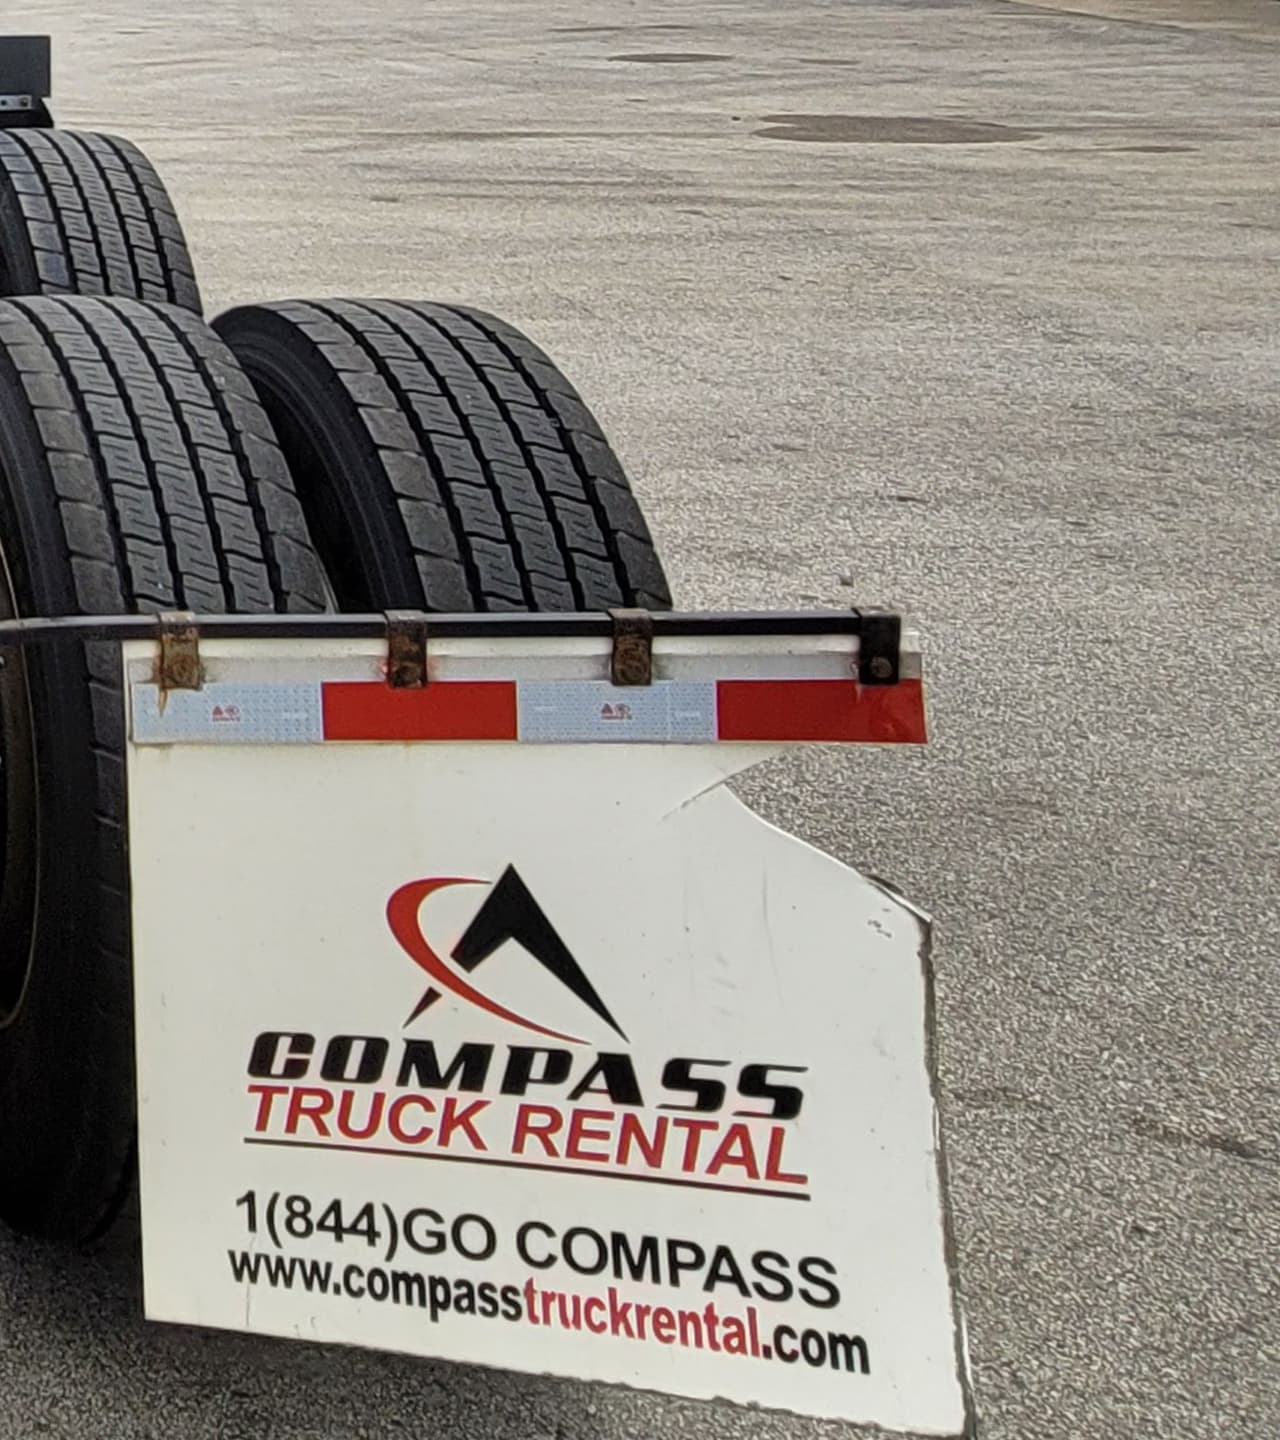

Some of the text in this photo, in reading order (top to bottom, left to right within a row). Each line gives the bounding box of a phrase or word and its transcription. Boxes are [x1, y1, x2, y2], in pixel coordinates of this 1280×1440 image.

[246, 1031, 809, 1121] COMPASS
[245, 1084, 809, 1185] TRUCK RENTAL
[227, 1246, 872, 1375] www.compasstruckrental.com
[516, 1220, 842, 1310] COMPASS
